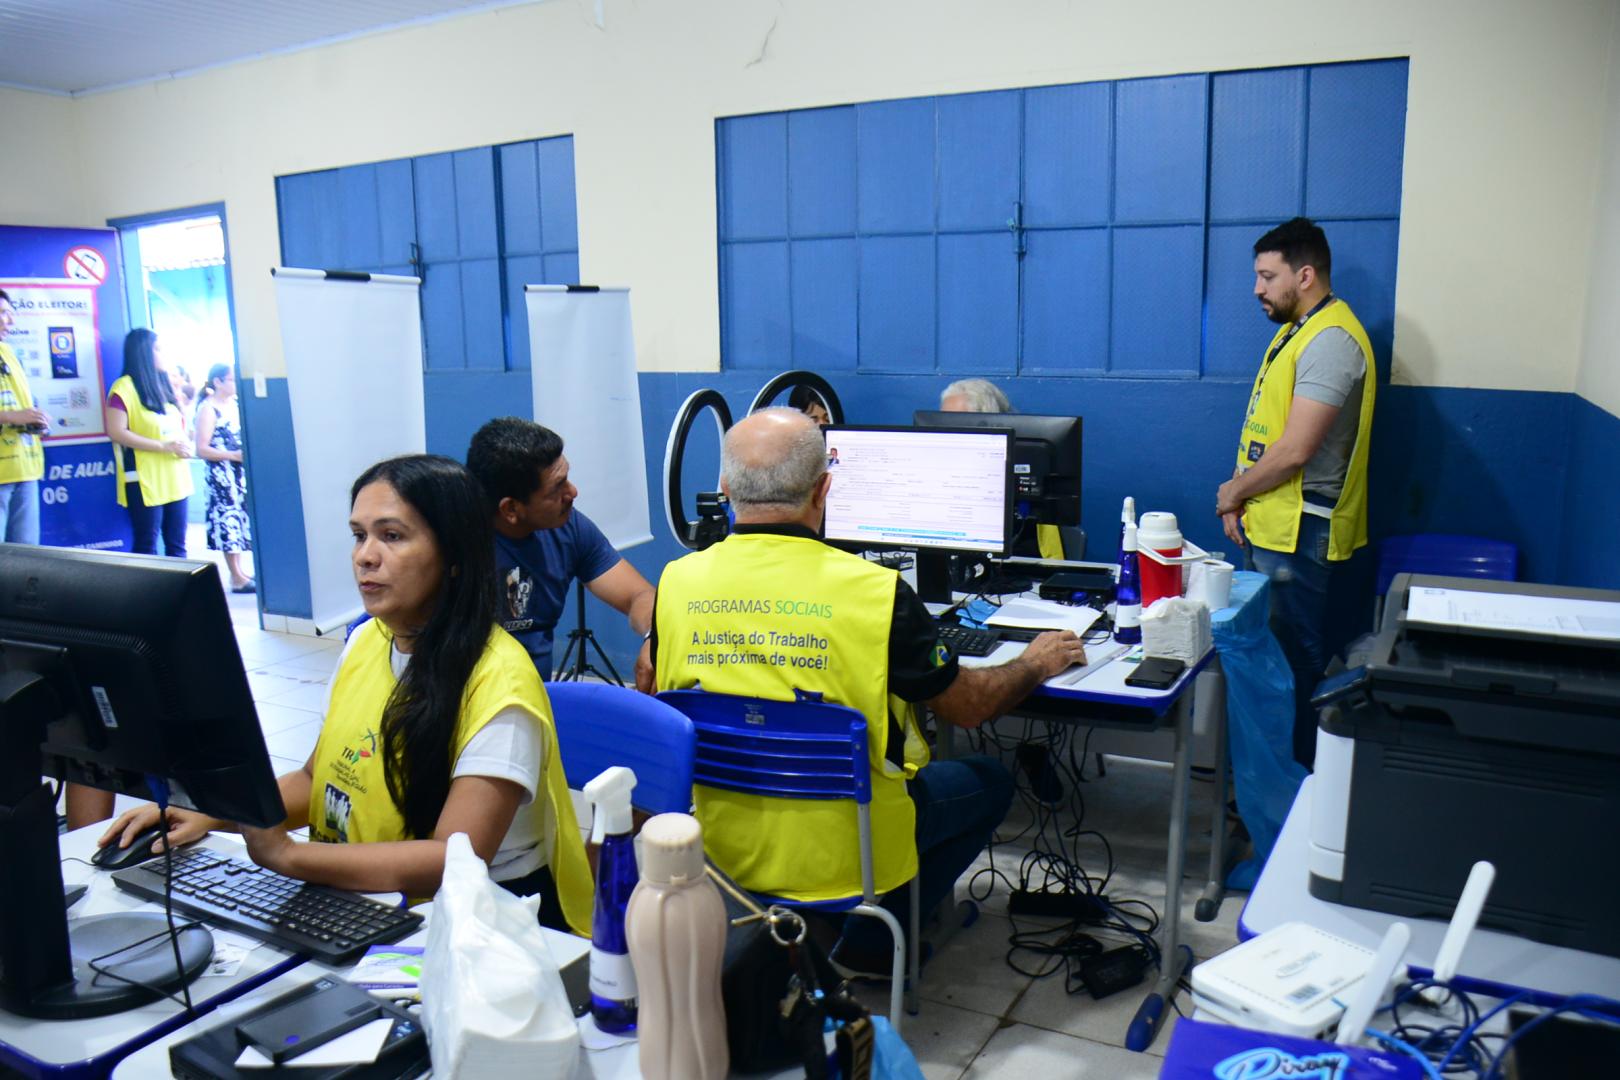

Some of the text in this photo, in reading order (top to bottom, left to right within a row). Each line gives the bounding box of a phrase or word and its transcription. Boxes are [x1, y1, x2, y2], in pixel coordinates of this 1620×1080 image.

[48, 460, 115, 480] DE AULA
[42, 485, 69, 505] 06
[687, 600, 832, 619] PROGRAMAS SOCIAIS
[692, 630, 828, 650] A Justiça do Trabalho
[687, 650, 829, 670] mais próxima de você!
